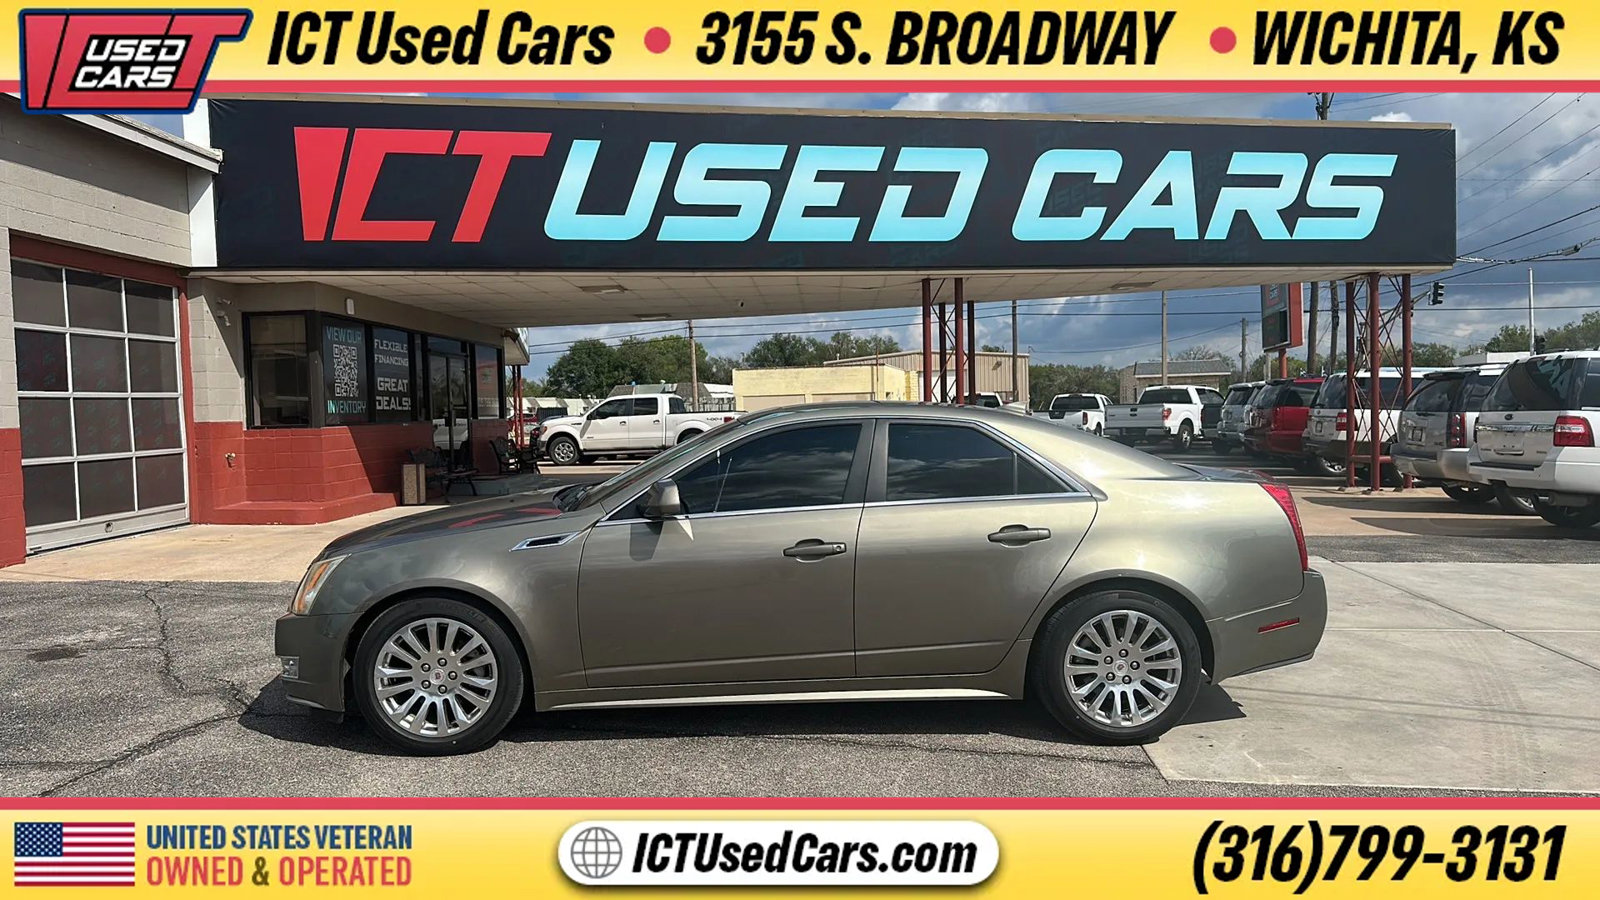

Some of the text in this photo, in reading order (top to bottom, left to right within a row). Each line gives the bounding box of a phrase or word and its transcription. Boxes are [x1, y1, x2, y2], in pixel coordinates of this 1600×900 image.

[293, 126, 1398, 243] ICT USED CARS
[326, 326, 362, 344] VIEW OUR
[374, 339, 409, 353] FLEXIBLE
[374, 354, 409, 367] FINANCING
[377, 377, 409, 392] GREAT
[327, 400, 367, 414] INVENTORY
[376, 396, 412, 411] DEALS!
